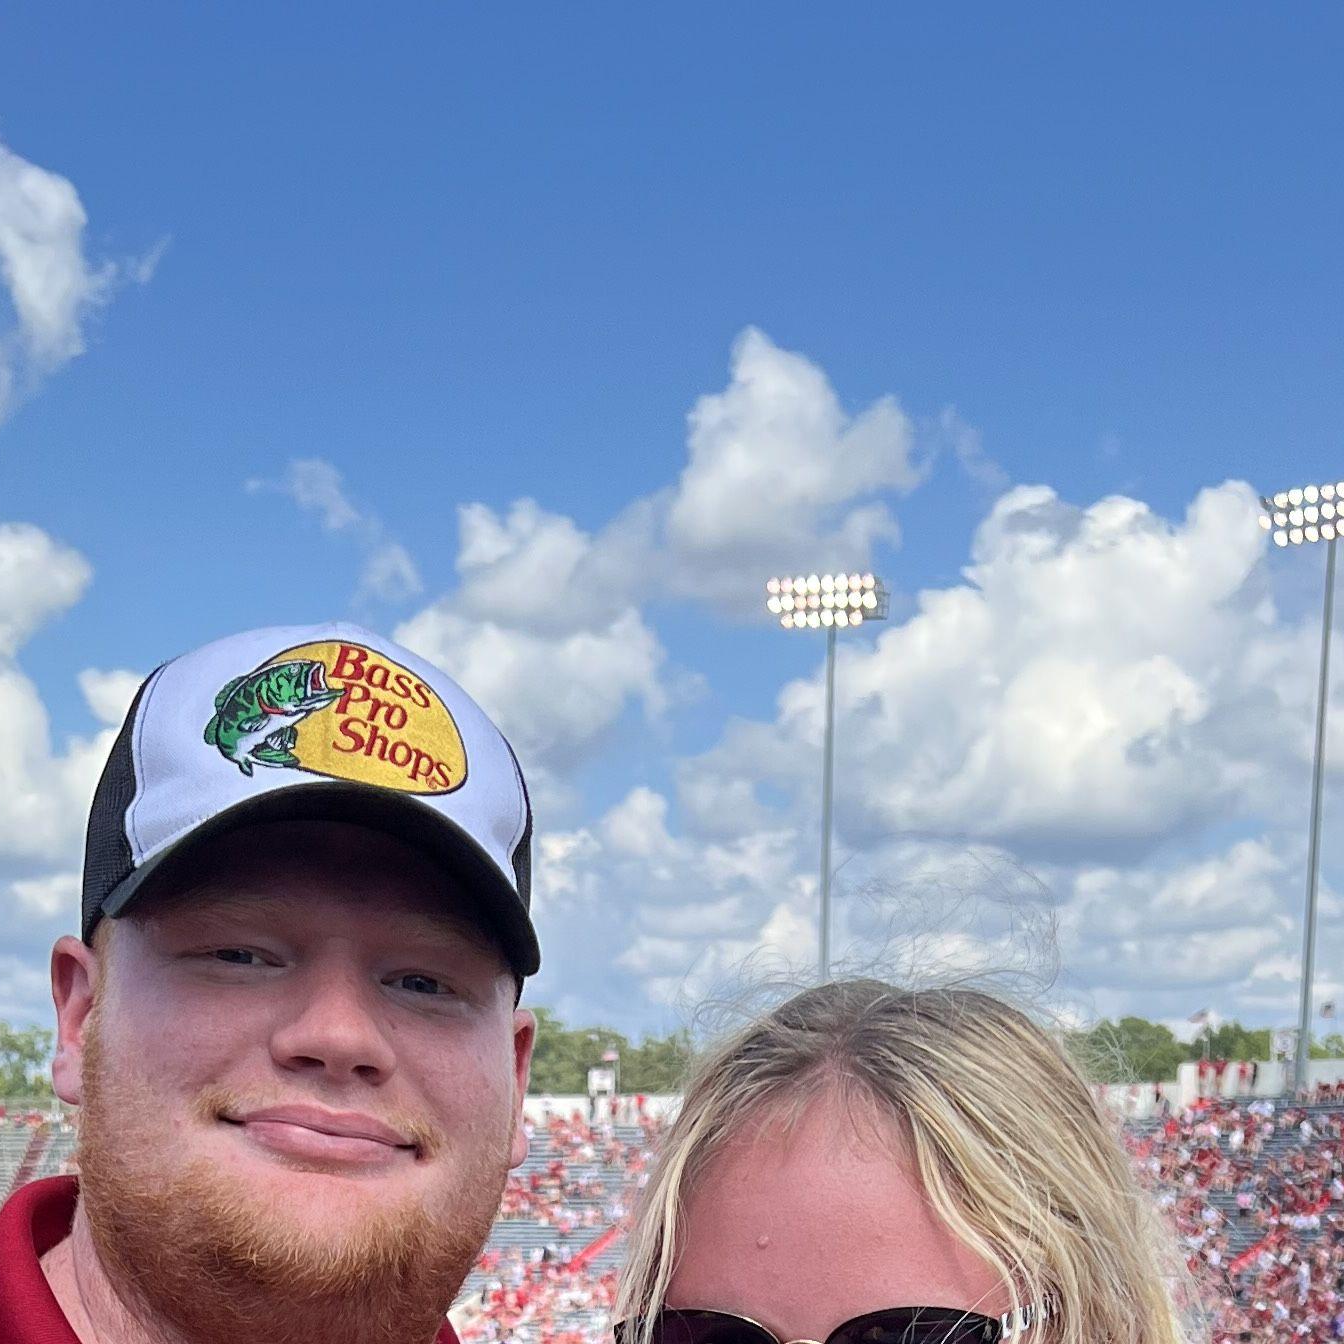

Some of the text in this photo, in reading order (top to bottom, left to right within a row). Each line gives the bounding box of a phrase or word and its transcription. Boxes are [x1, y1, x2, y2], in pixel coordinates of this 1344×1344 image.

[329, 644, 432, 709] Bass
[334, 682, 408, 730] Pro
[332, 718, 452, 790] Shops
